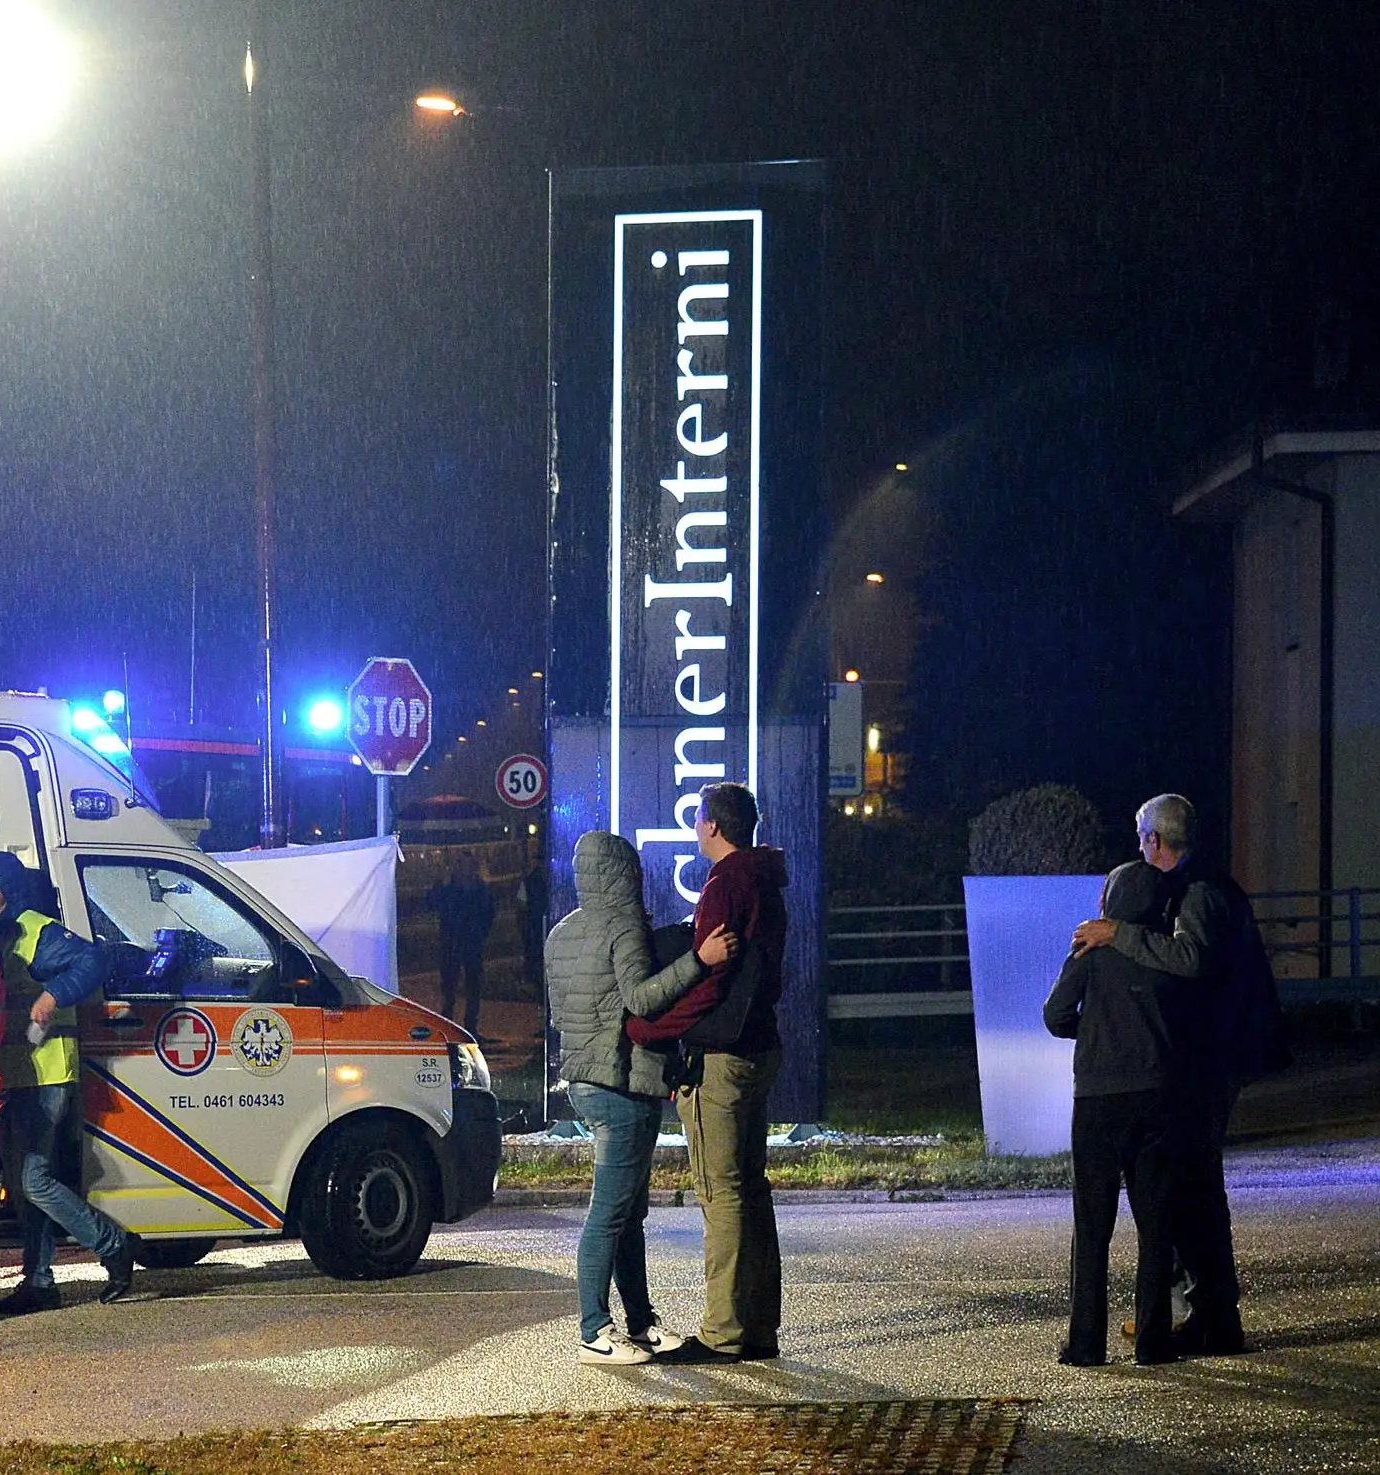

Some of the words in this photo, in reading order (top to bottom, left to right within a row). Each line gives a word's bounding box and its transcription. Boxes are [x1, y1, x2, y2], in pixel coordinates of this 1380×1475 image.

[635, 249, 733, 924] chnerInterni
[353, 695, 426, 739] STOP
[508, 770, 537, 795] 50
[422, 1058, 440, 1068] S.R.
[416, 1073, 443, 1083] 12537
[169, 1096, 200, 1109] TEL.
[203, 1095, 234, 1108] 0461
[238, 1093, 285, 1107] 604343
